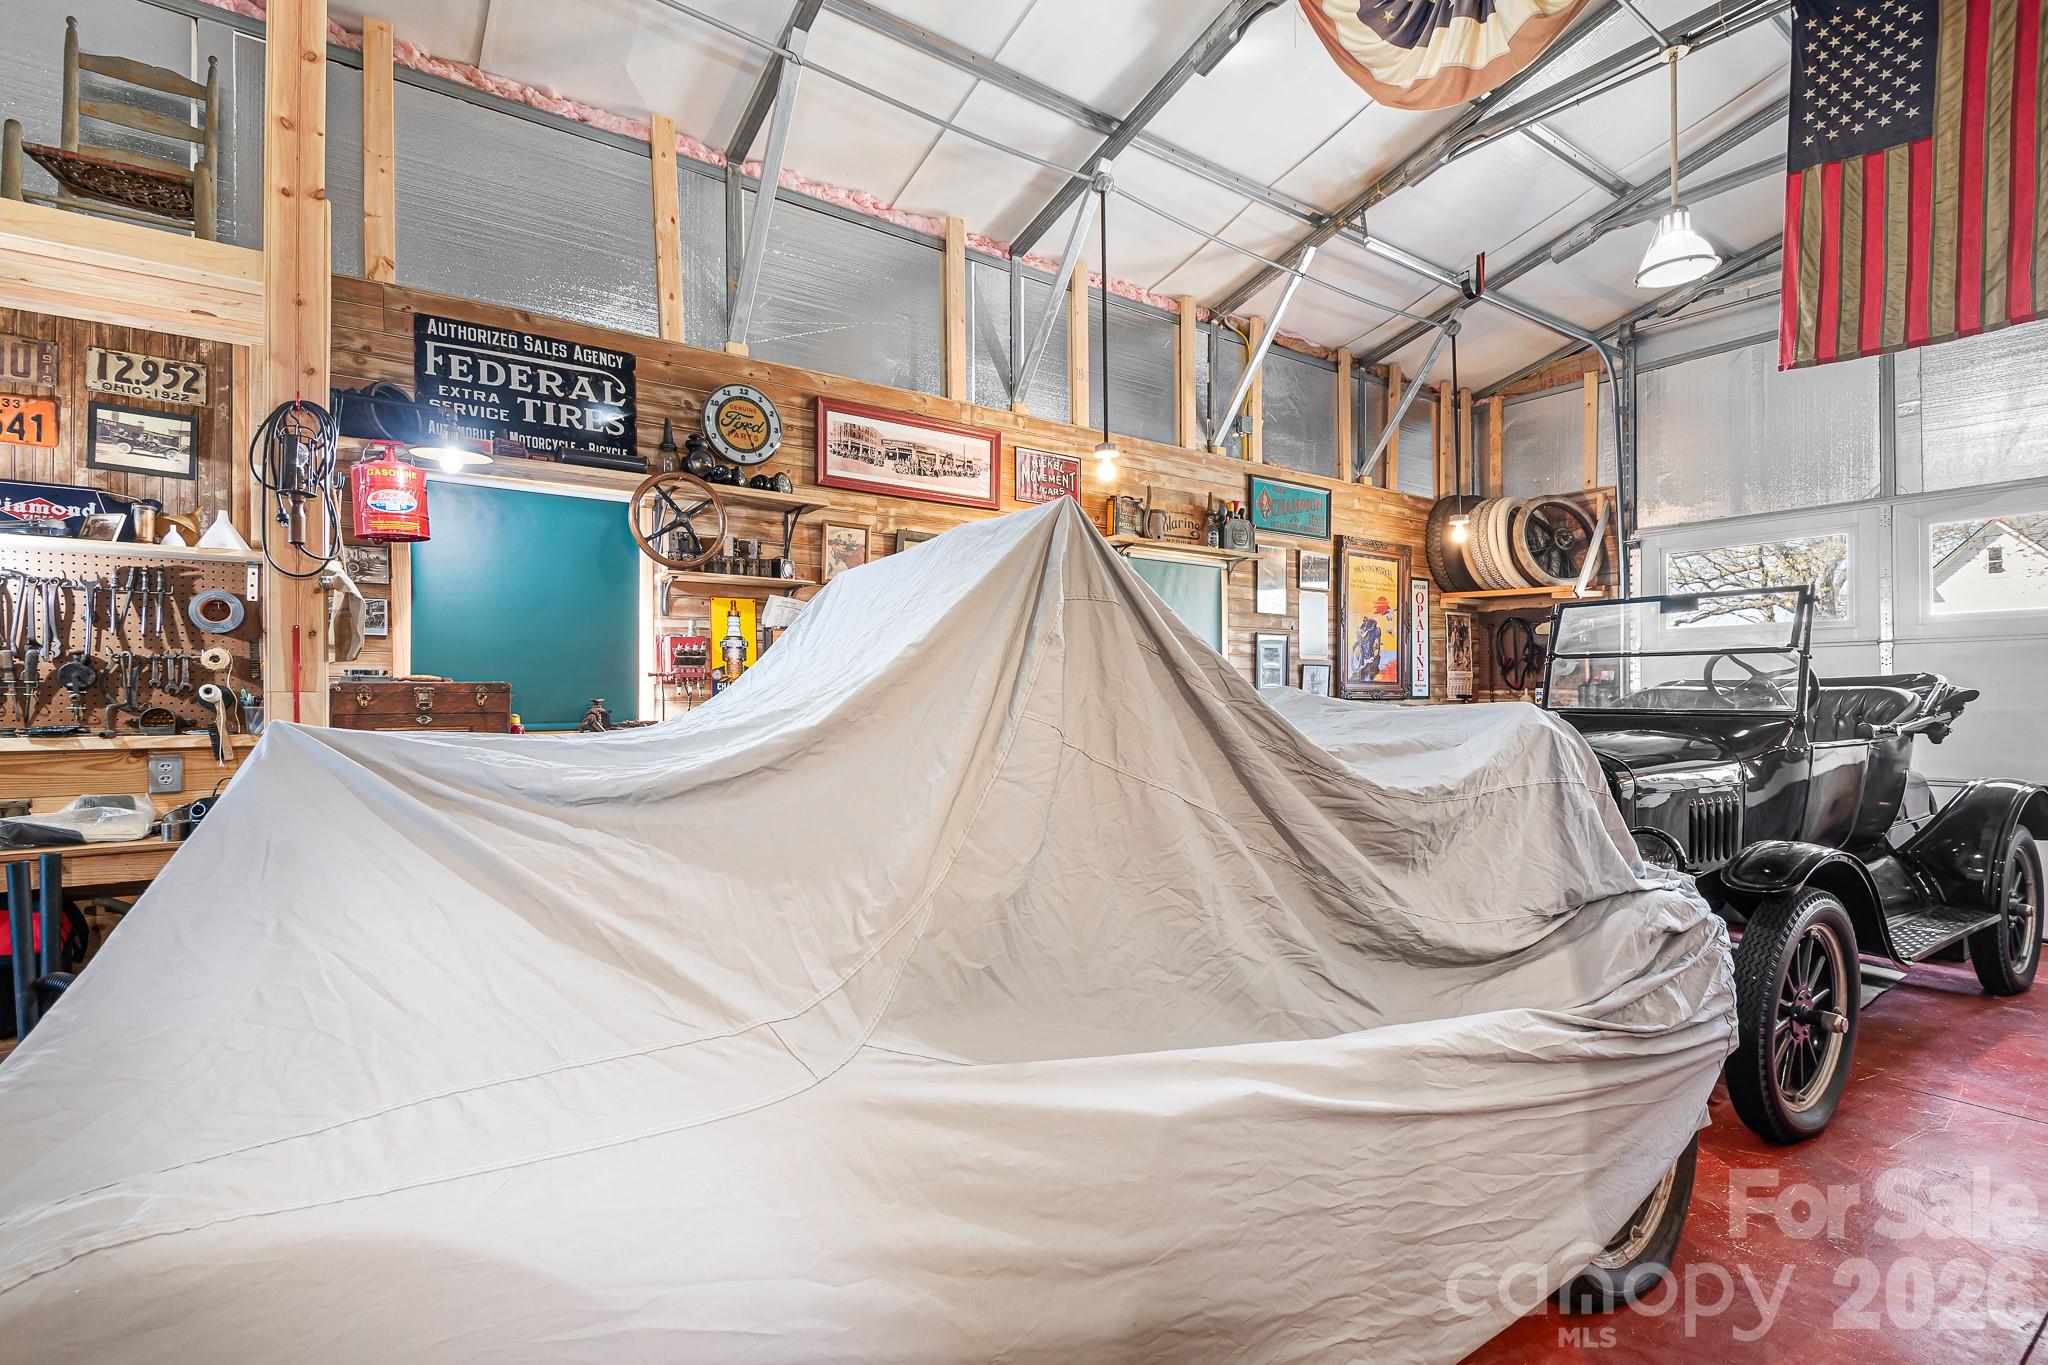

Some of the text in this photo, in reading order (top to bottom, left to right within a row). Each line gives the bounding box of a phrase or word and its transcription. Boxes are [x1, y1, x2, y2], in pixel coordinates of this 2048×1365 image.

[427, 318, 624, 369] AUTHORIZED SALES AGENCY
[424, 340, 626, 407] FEDERAL
[438, 385, 500, 404] EXTRA
[710, 399, 720, 407] 10
[516, 396, 625, 436] TIRES
[729, 403, 757, 414] GENUINE
[0, 411, 43, 443] 41
[428, 420, 495, 442] AUTMOBILE
[720, 410, 765, 434] Ford
[1021, 463, 1076, 492] MOVEMENT
[1033, 483, 1066, 496] CIGARS
[0, 497, 97, 517] iamond
[1415, 592, 1425, 682] OPALINE
